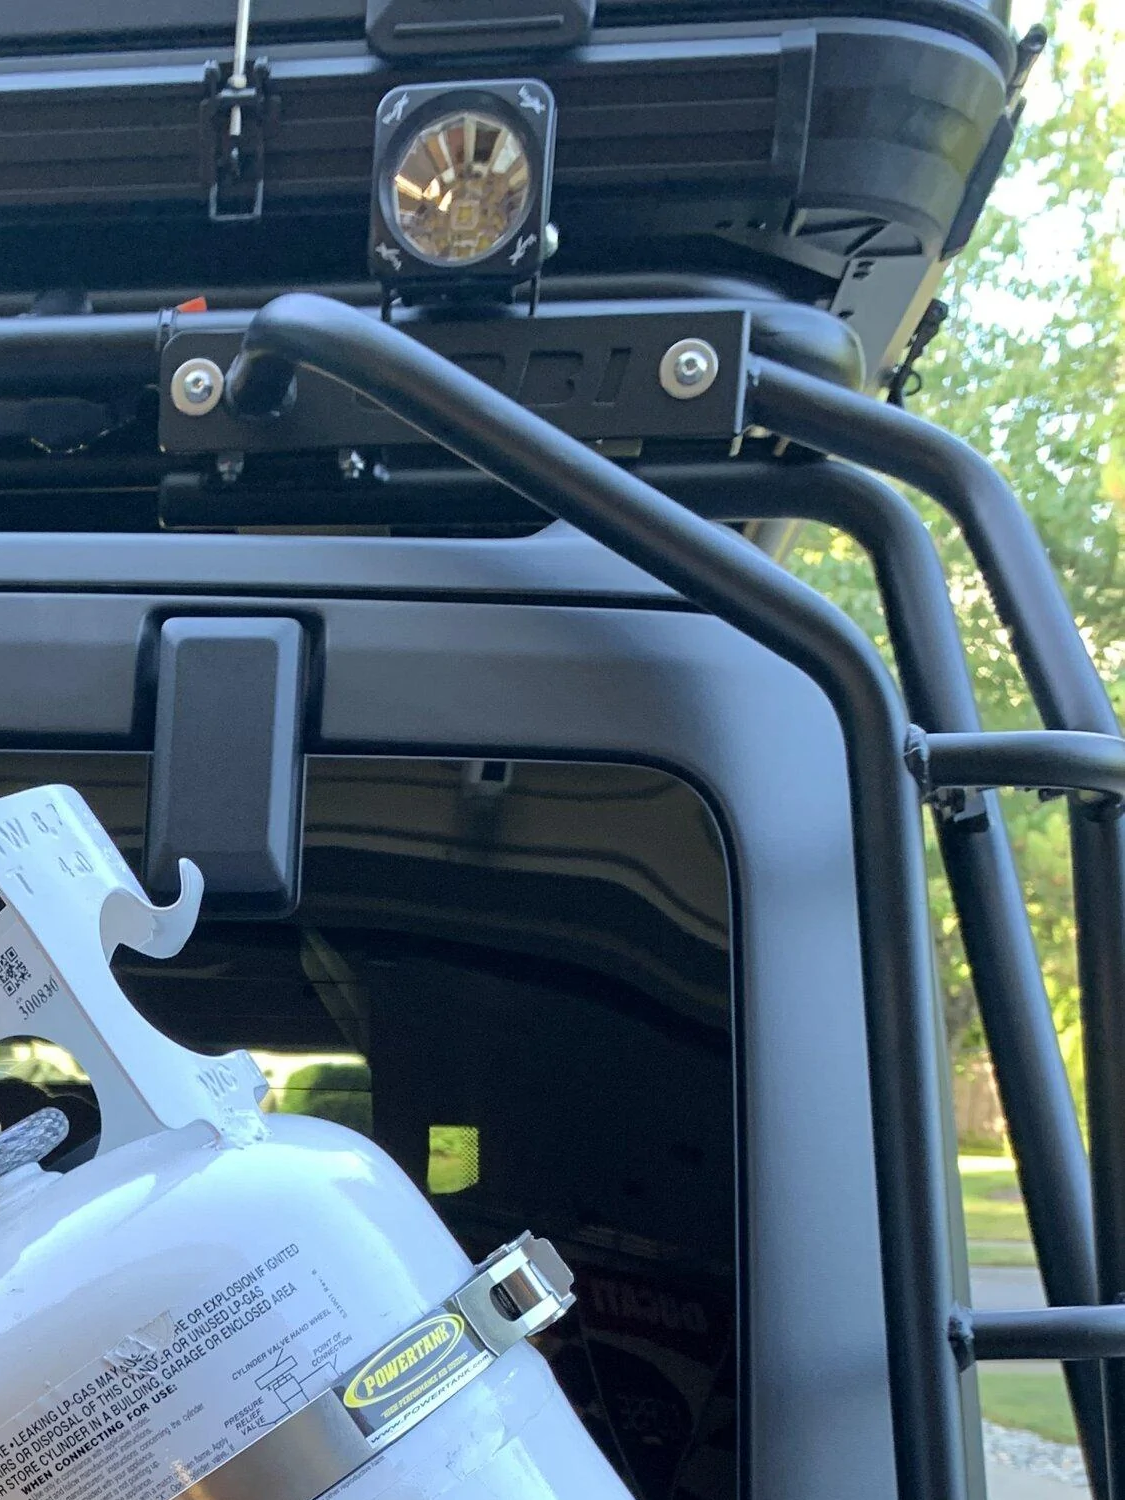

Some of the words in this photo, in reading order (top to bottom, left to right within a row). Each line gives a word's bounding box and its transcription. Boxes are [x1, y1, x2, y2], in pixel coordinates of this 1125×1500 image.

[12, 1409, 59, 1447] LEAKING
[56, 1382, 97, 1416] LP-GAS
[94, 1366, 121, 1389] MAY
[186, 1307, 205, 1325] OR
[202, 1271, 256, 1314] EXPLOSION
[254, 1265, 267, 1278] IF
[264, 1242, 300, 1272] IGNITED
[14, 1446, 33, 1464] OR
[30, 1411, 83, 1453] DISPOSAL
[81, 1400, 99, 1417] OF
[97, 1383, 123, 1406] THIS
[171, 1336, 190, 1355] OR
[187, 1308, 230, 1343] UNUSED
[227, 1284, 265, 1316] LP-GAS
[230, 1351, 268, 1381] CYLINDER
[266, 1335, 291, 1356] VALVE
[289, 1322, 309, 1340] HAND
[309, 1307, 331, 1326] WHEEL
[310, 1334, 353, 1367] CONNECTION
[312, 1339, 332, 1356] POINT
[331, 1331, 344, 1342] OF
[362, 1322, 450, 1397] POWERTANK
[4, 1460, 40, 1490] STORE
[38, 1425, 91, 1467] CYLINDER
[88, 1415, 104, 1431] IN
[100, 1409, 112, 1423] A
[110, 1373, 164, 1417] BUILDING,
[160, 1344, 206, 1381] GARAGE
[203, 1333, 223, 1351] OR
[220, 1298, 273, 1340] ENCLOSED
[270, 1281, 297, 1305] AREA
[223, 1396, 264, 1428] PRESSURE
[235, 1408, 262, 1430] RELIEF
[20, 1469, 53, 1496] WHEN
[54, 1419, 125, 1473] CONNECTING
[126, 1401, 150, 1421] FOR
[150, 1382, 178, 1405] USE:
[240, 1415, 266, 1436] VALVE
